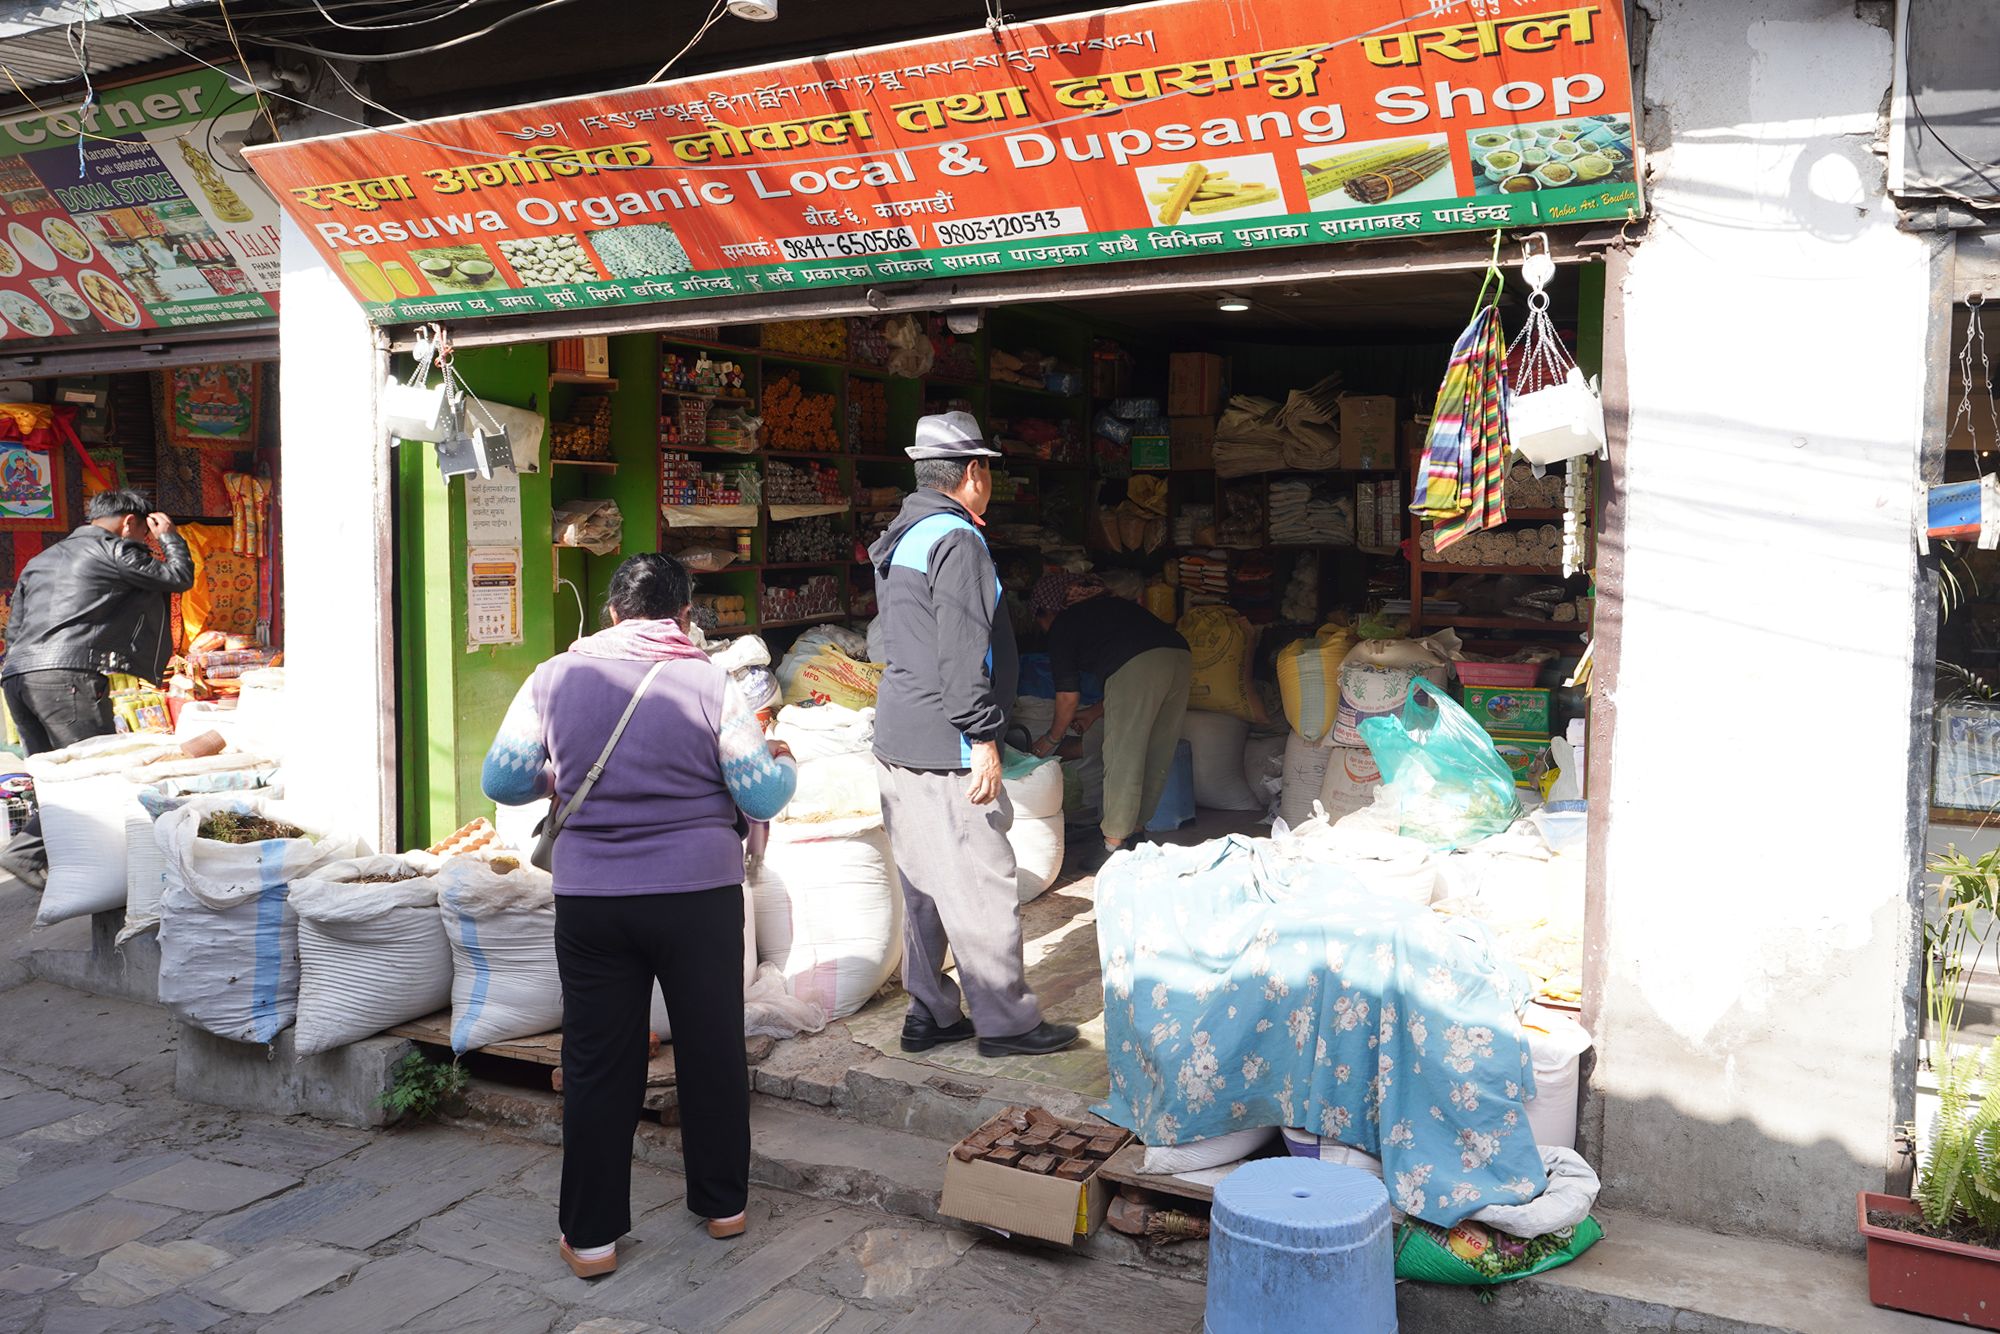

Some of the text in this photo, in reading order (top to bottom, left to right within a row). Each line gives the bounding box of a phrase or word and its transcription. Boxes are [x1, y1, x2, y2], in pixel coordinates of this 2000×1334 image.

[3, 85, 203, 145] Corner
[289, 175, 416, 211] रसुवा
[667, 108, 874, 162] लोकल
[890, 85, 1030, 132] तथा
[1358, 5, 1601, 66] पसल
[96, 164, 116, 175] Cell:
[316, 210, 508, 249] Rasuwa
[516, 178, 735, 226] Organic
[746, 150, 916, 200] Local
[938, 142, 988, 176] &
[1004, 103, 1346, 166] Dupsang
[1375, 72, 1605, 124] Shop
[55, 171, 184, 212] DOMA STORE
[872, 190, 956, 219] काठमाडौं
[1549, 203, 1577, 218] Nabin
[1601, 189, 1636, 205] Boudha
[225, 230, 275, 257] YALA
[720, 236, 778, 261] सम्पर्क:
[783, 227, 913, 260] 9844-650566
[938, 211, 1061, 245] 9803-120543
[371, 303, 397, 318] यहाँ
[586, 284, 627, 301] सिमी
[630, 279, 677, 297] खरिद
[745, 274, 762, 288] र
[766, 267, 794, 284] सबै
[876, 258, 934, 275] लोकल
[941, 251, 1001, 270] सामान
[1008, 243, 1089, 263] पाउनुका
[1097, 233, 1139, 256] साथै
[1148, 230, 1224, 250] विभिन्न
[1232, 222, 1309, 246] पुजाका
[1320, 211, 1422, 237] सामानहरु
[1432, 201, 1512, 224] पाईन्छ
[1454, 1226, 1482, 1249] 25 KG
